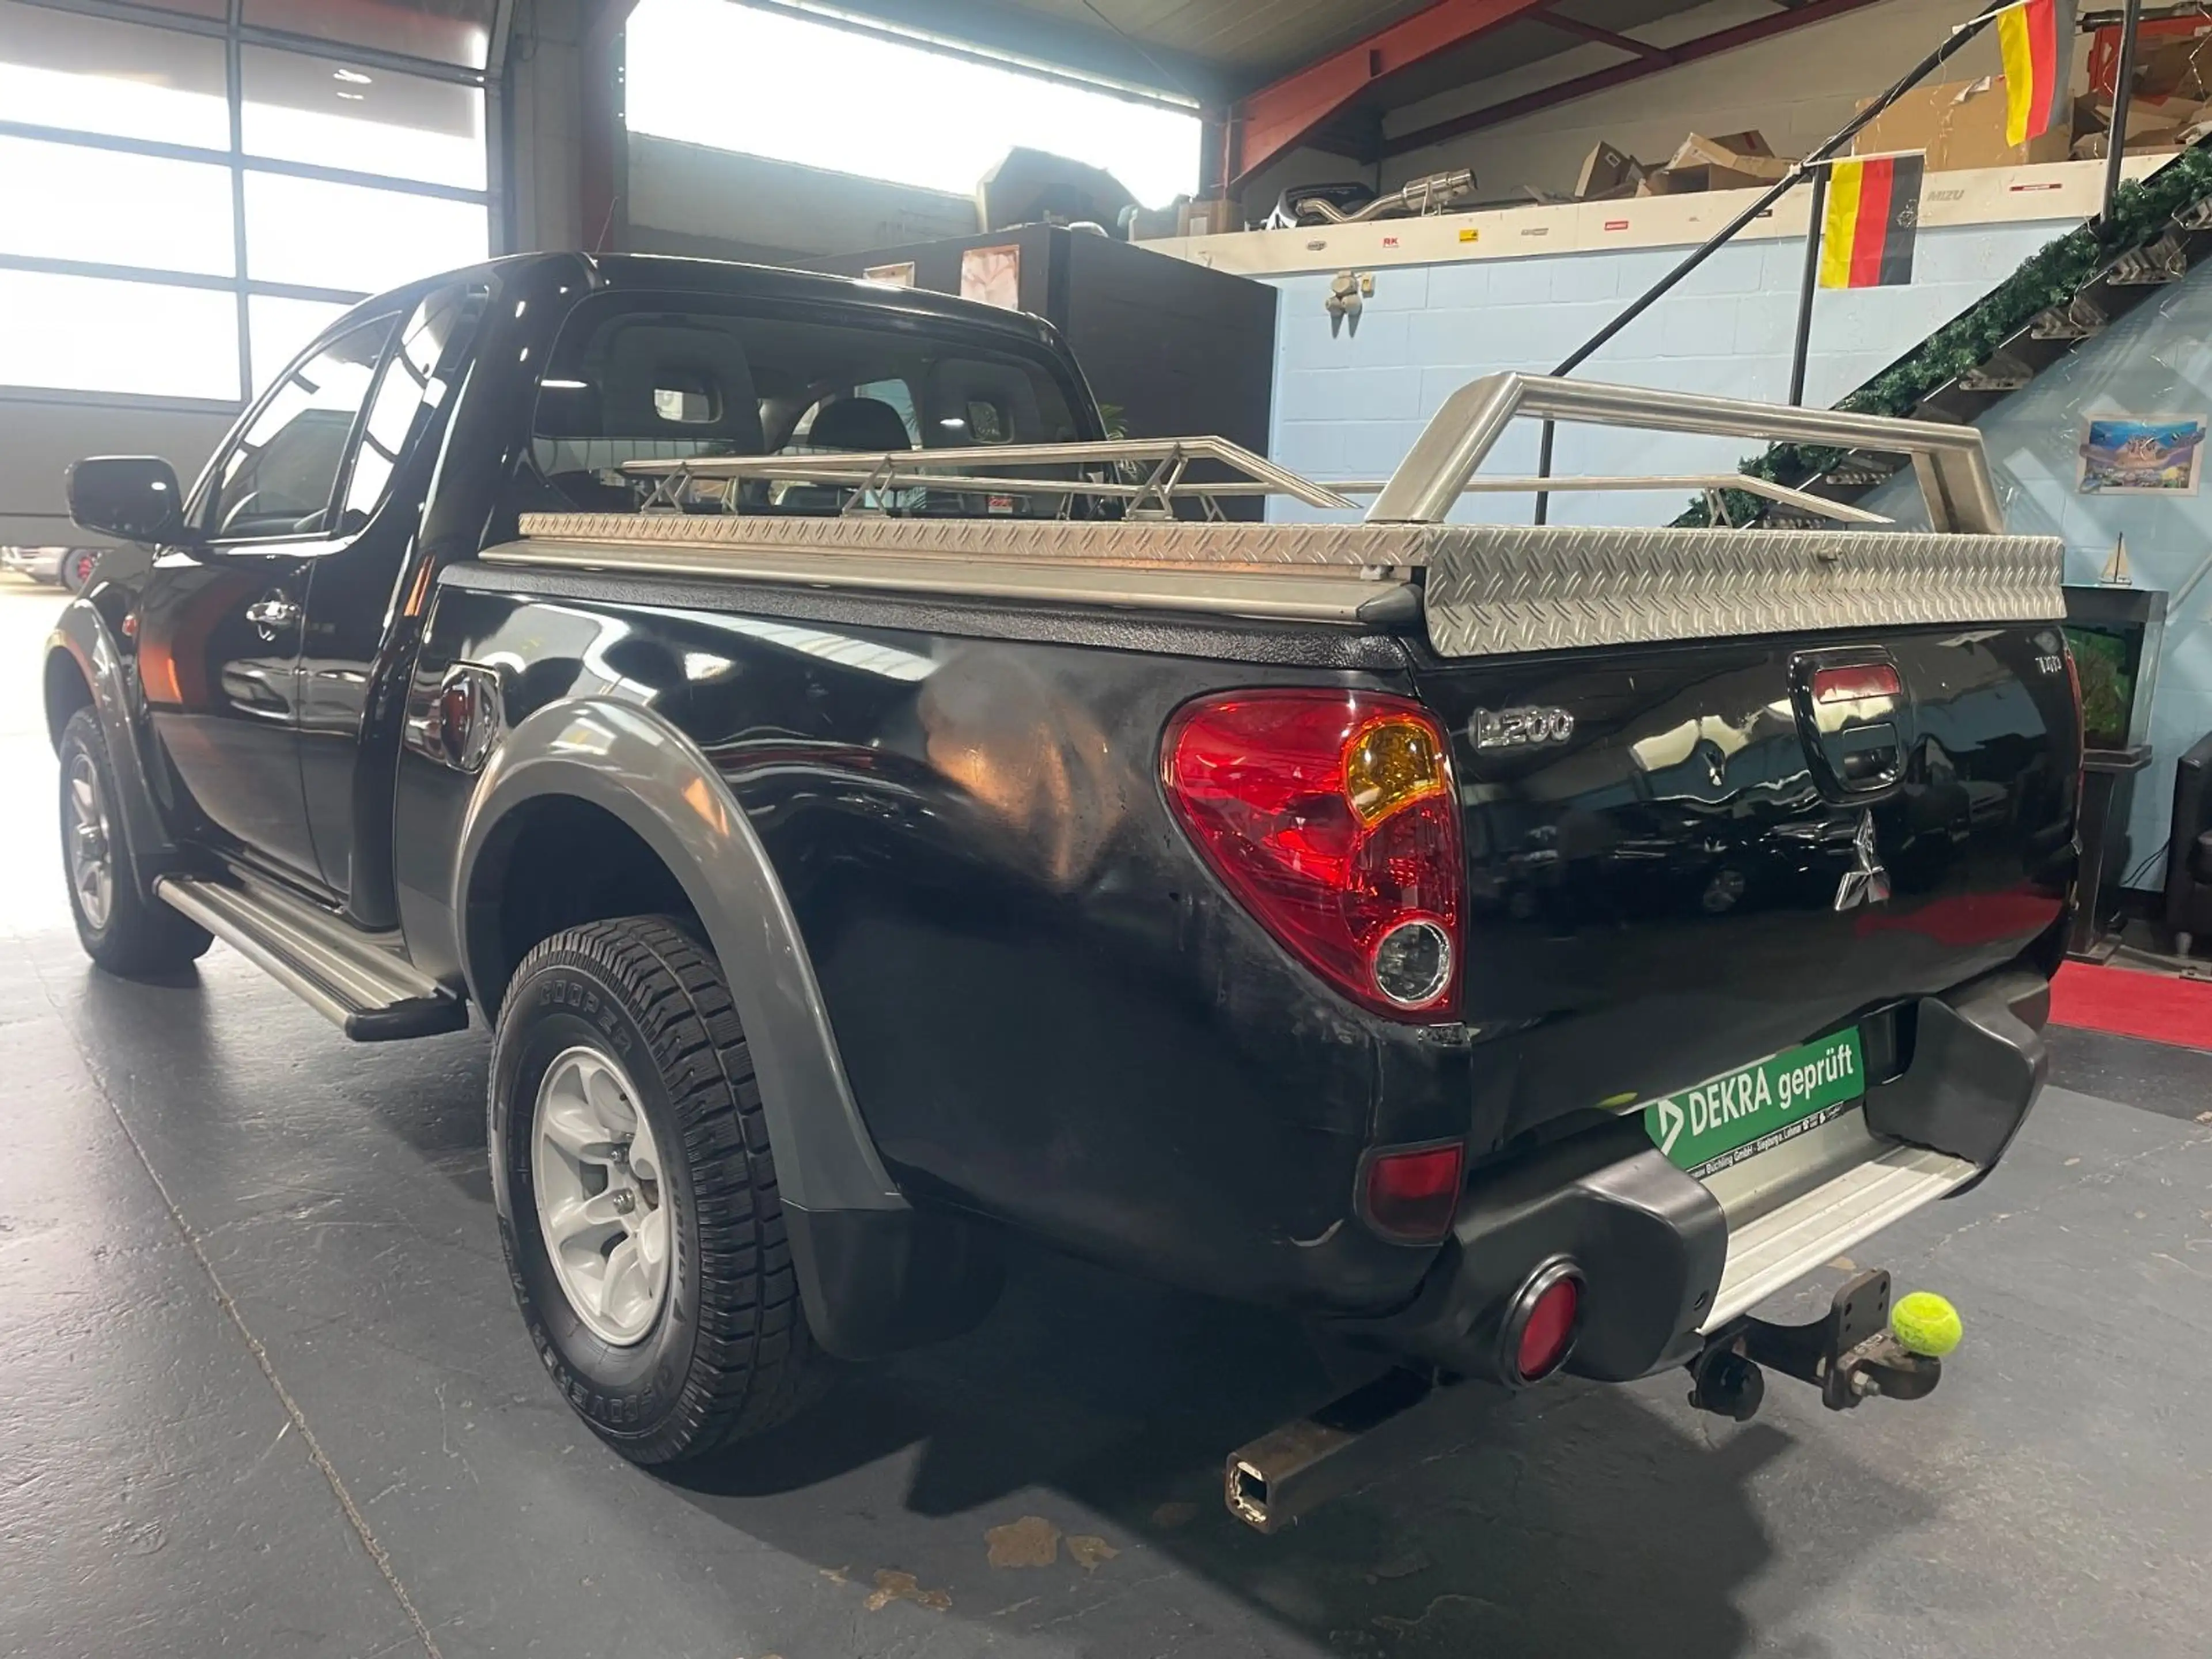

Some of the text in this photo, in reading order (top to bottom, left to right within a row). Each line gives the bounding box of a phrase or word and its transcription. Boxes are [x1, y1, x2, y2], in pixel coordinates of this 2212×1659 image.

[1476, 708, 1574, 749] L200
[539, 979, 632, 1058] COOPER
[1688, 1043, 1854, 1136] DEKRA geprüft
